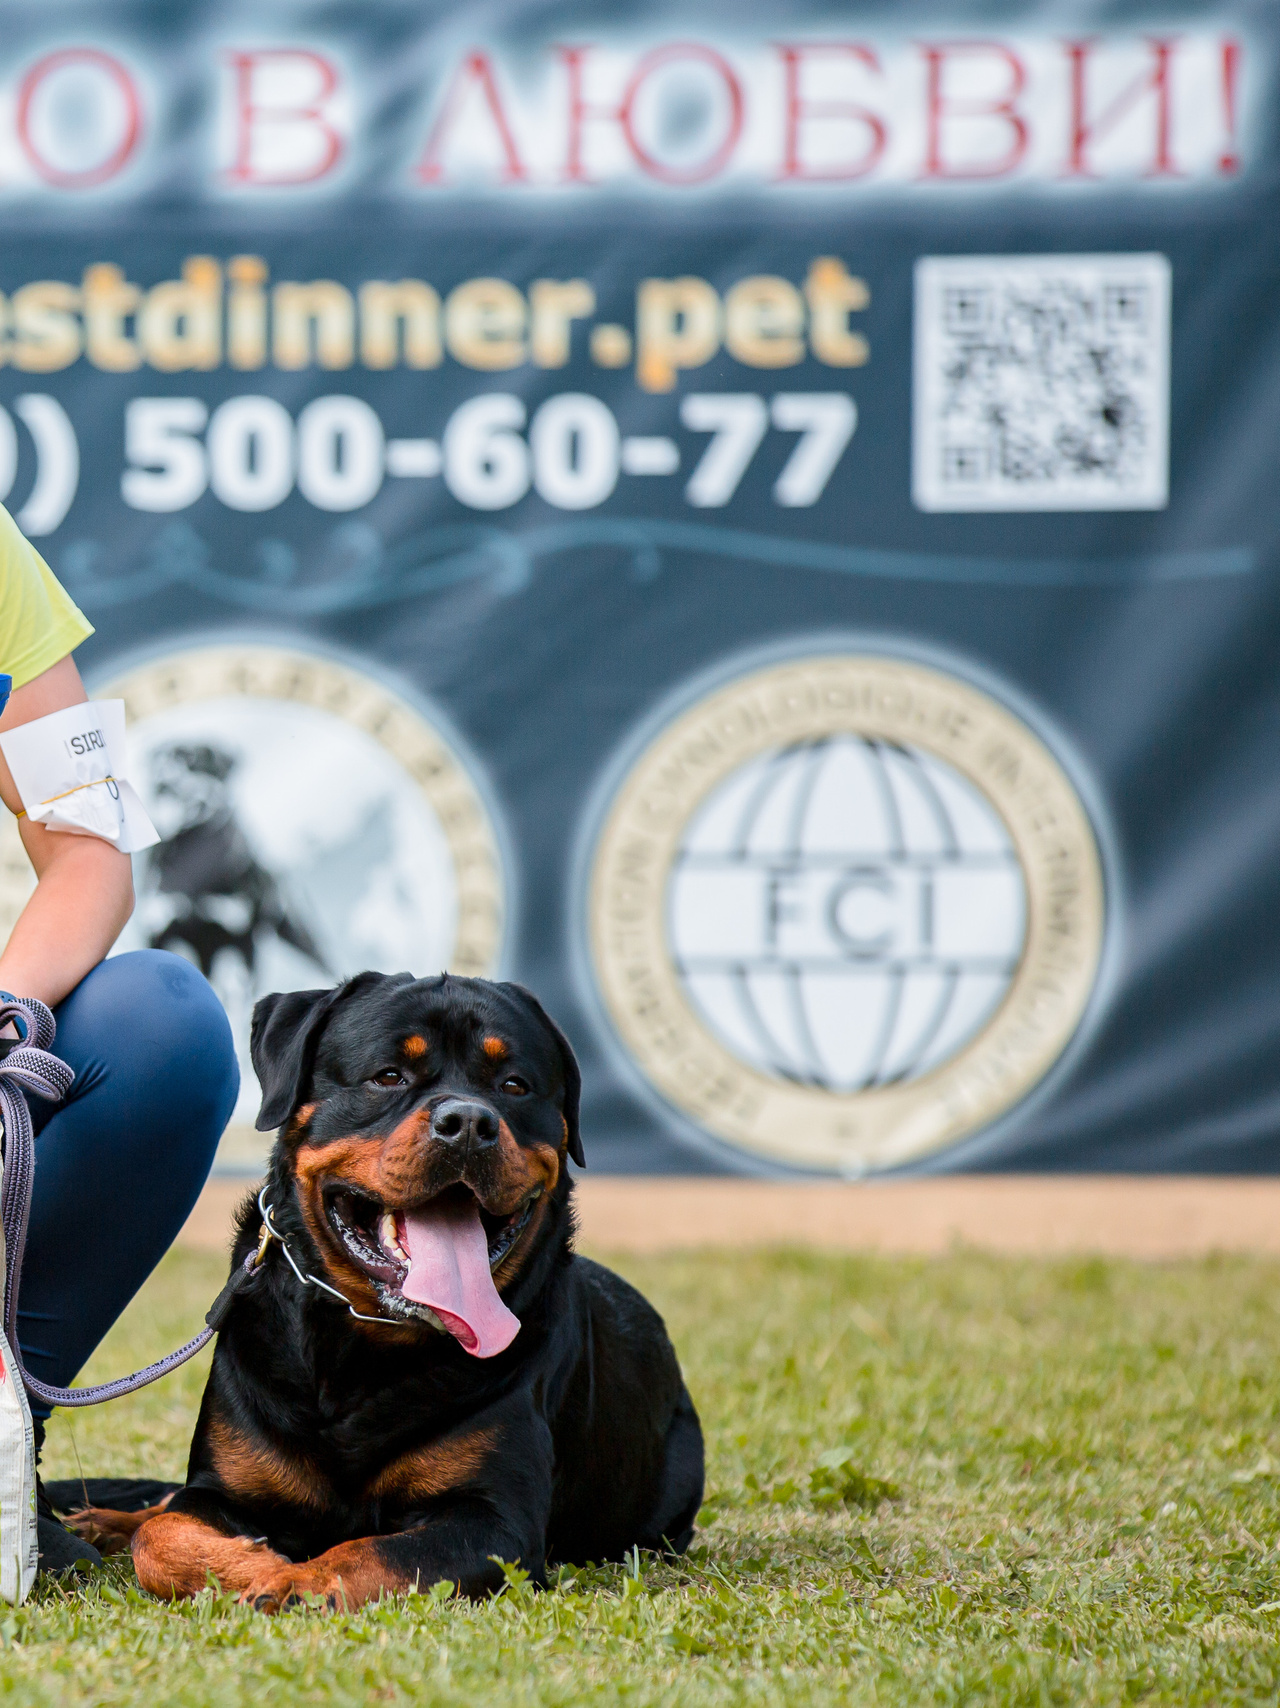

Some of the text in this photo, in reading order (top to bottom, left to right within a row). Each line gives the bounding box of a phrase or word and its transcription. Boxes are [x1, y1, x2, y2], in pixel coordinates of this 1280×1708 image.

[219, 46, 345, 187] В
[411, 37, 1244, 187] ЛЮБВИ!
[121, 392, 858, 512] 500-60-77
[763, 864, 937, 961] FCI
